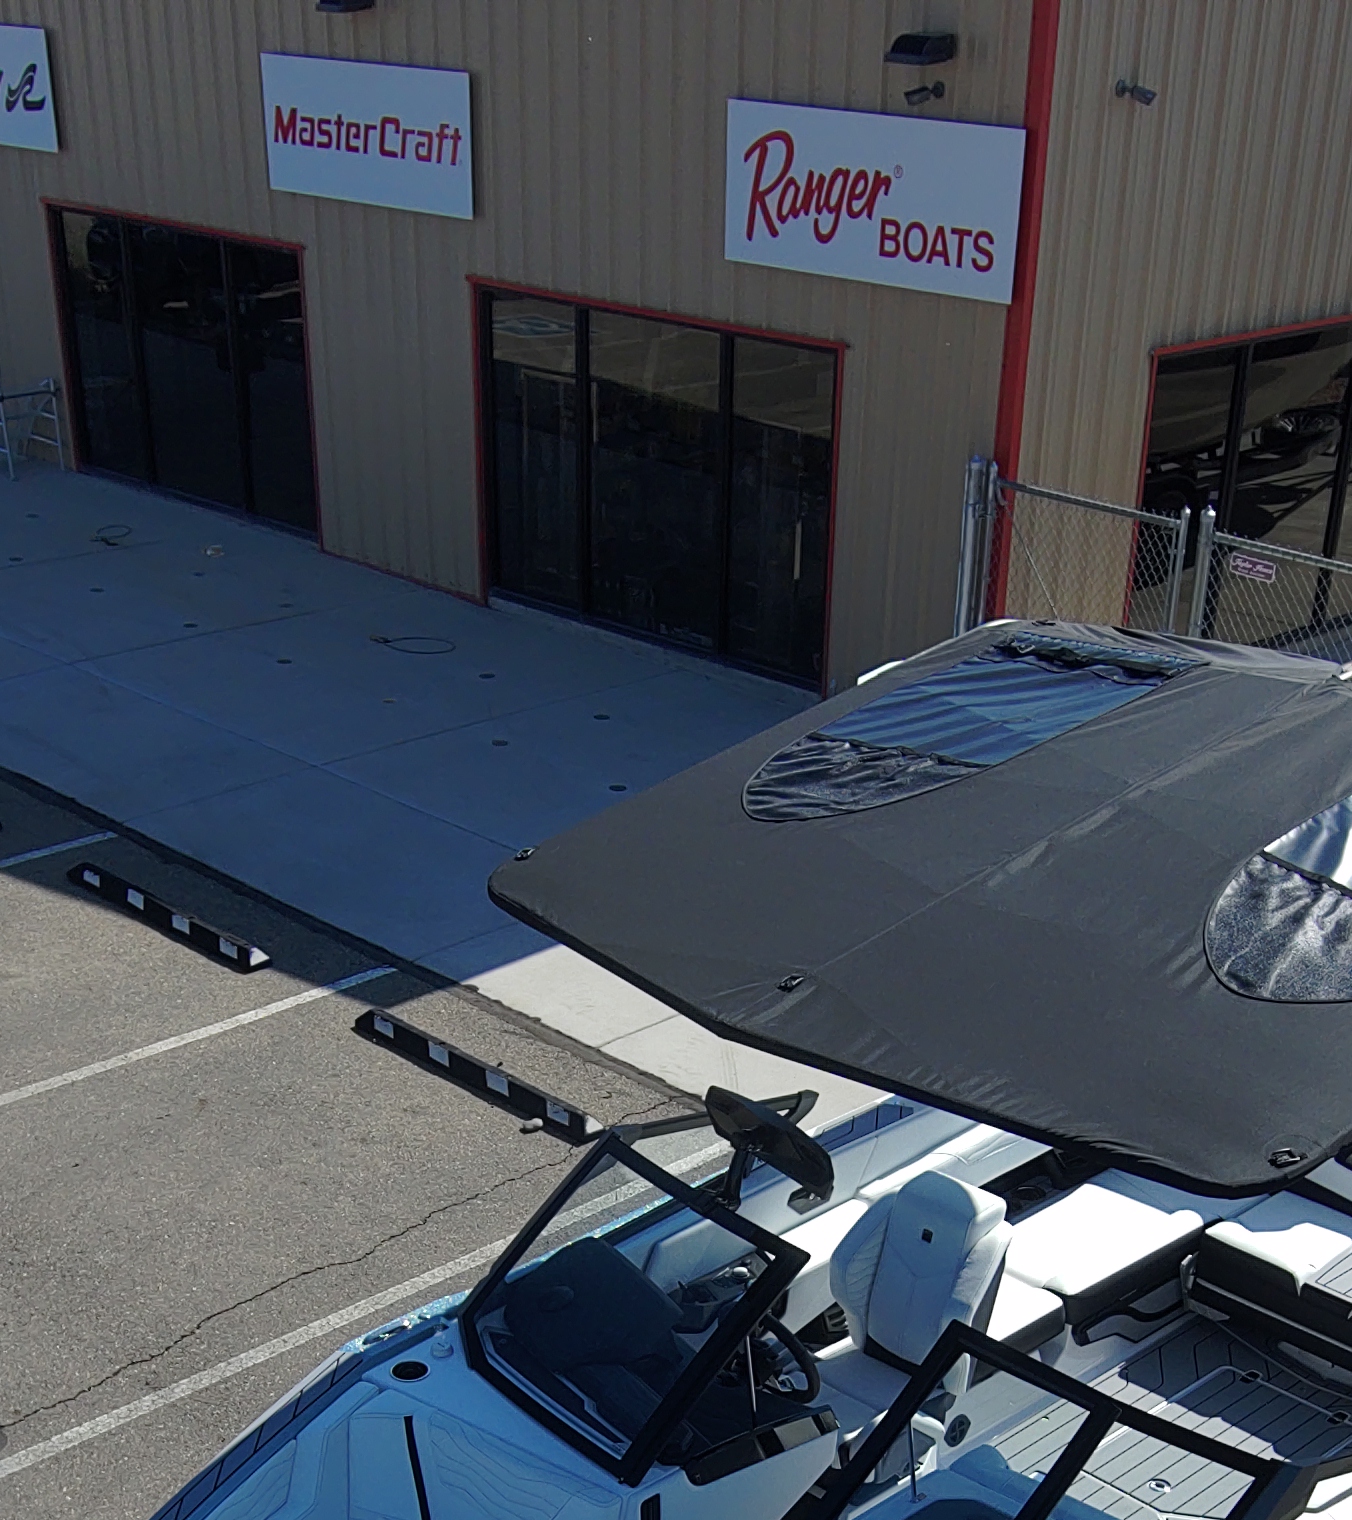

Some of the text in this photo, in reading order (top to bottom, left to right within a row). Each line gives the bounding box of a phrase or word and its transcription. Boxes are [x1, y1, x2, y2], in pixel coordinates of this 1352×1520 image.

[274, 105, 462, 166] MasterCraft
[744, 130, 892, 244] Ranger
[879, 217, 994, 272] BOATS
